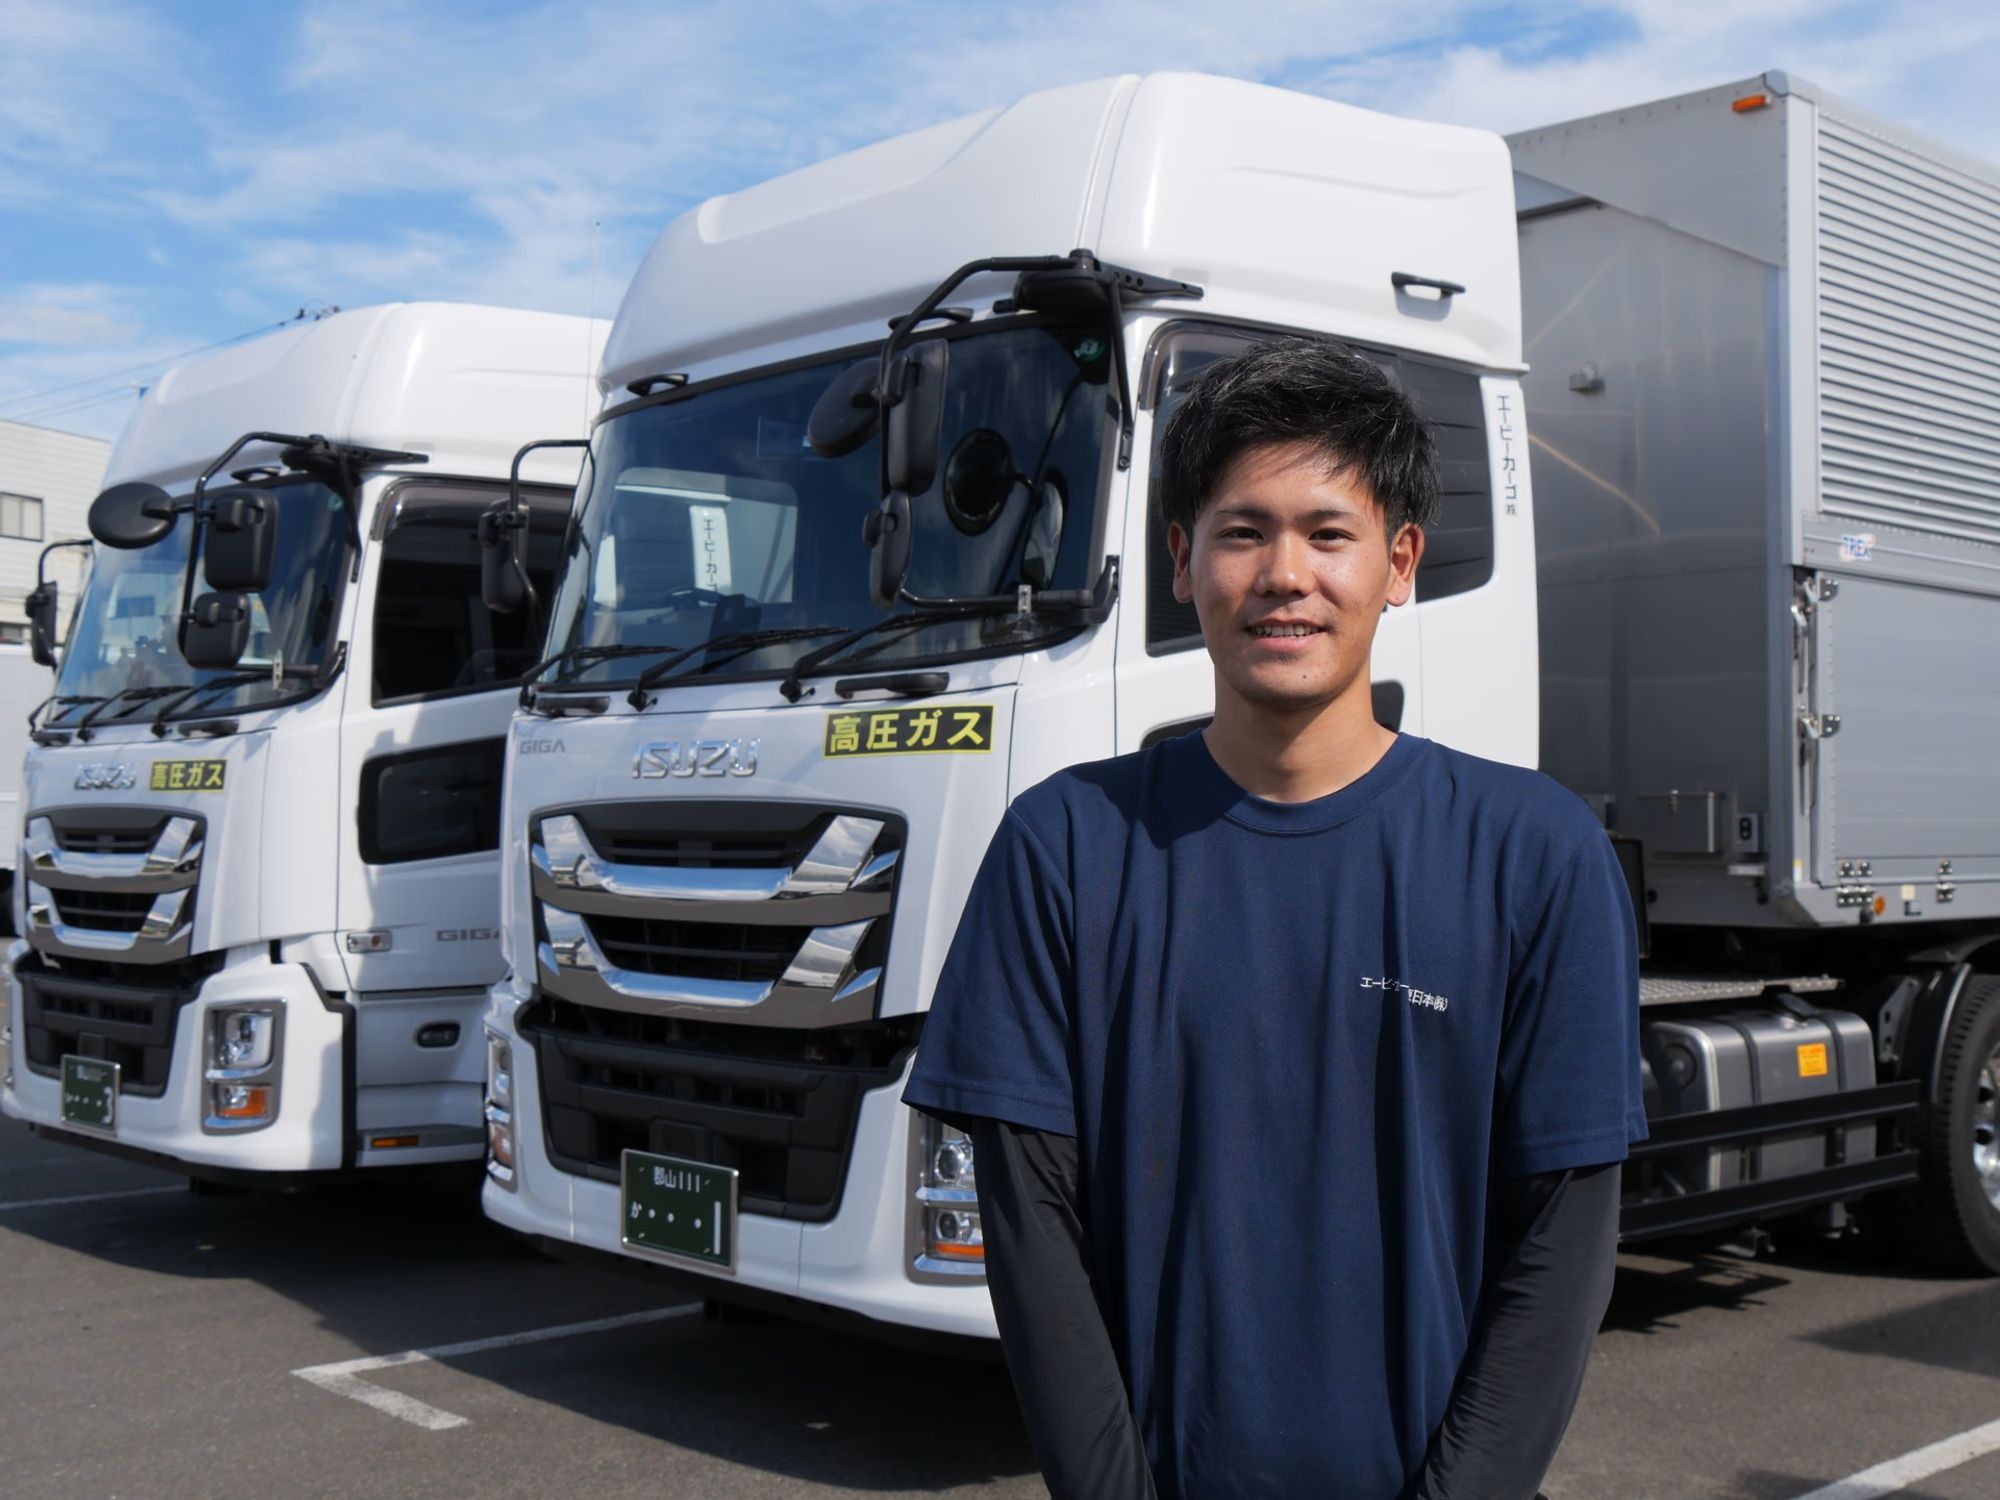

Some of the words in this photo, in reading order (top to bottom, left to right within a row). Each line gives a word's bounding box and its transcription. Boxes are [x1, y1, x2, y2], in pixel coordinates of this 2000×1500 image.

[519, 739, 566, 754] GIGA
[830, 709, 984, 752] 高圧ガス
[152, 762, 222, 788] 高圧ガス
[631, 739, 760, 779] ISUZU
